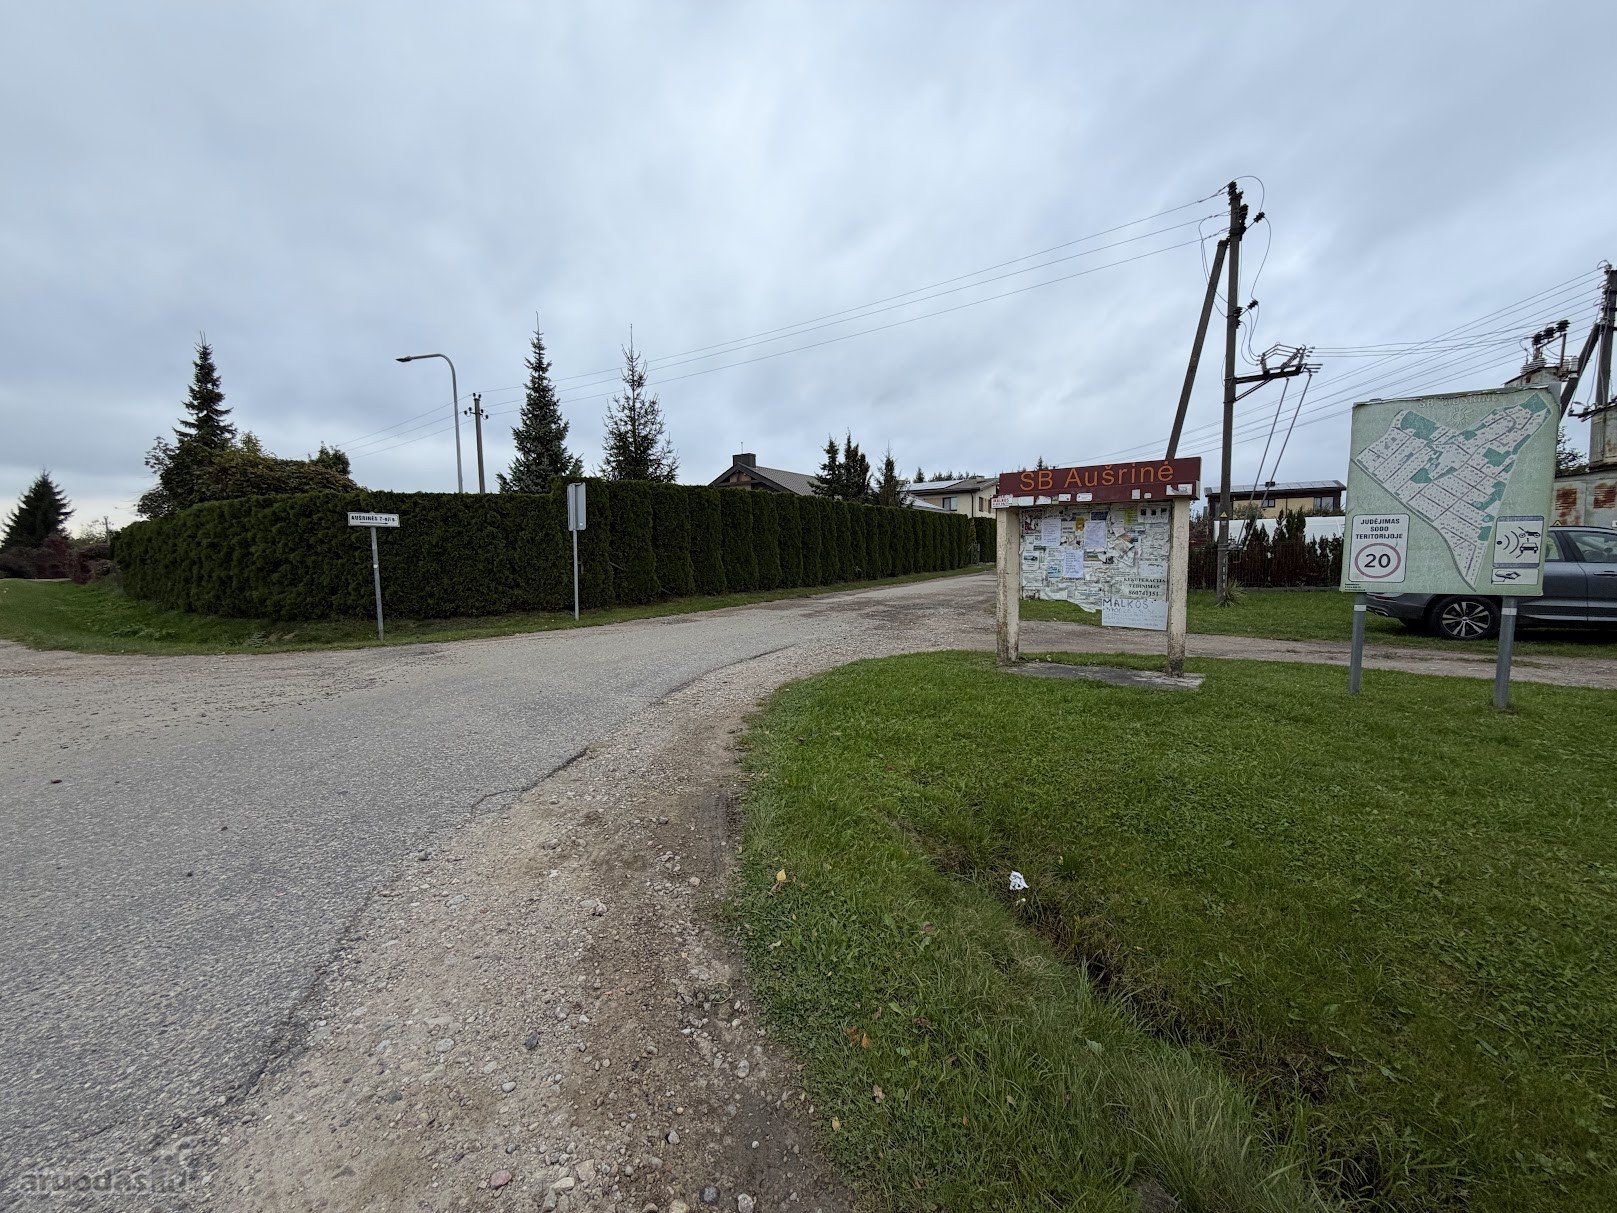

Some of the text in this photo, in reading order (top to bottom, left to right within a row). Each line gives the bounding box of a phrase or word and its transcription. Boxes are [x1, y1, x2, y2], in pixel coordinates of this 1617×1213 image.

[1020, 460, 1174, 491] SB Aušrinė
[1364, 553, 1391, 568] 20
